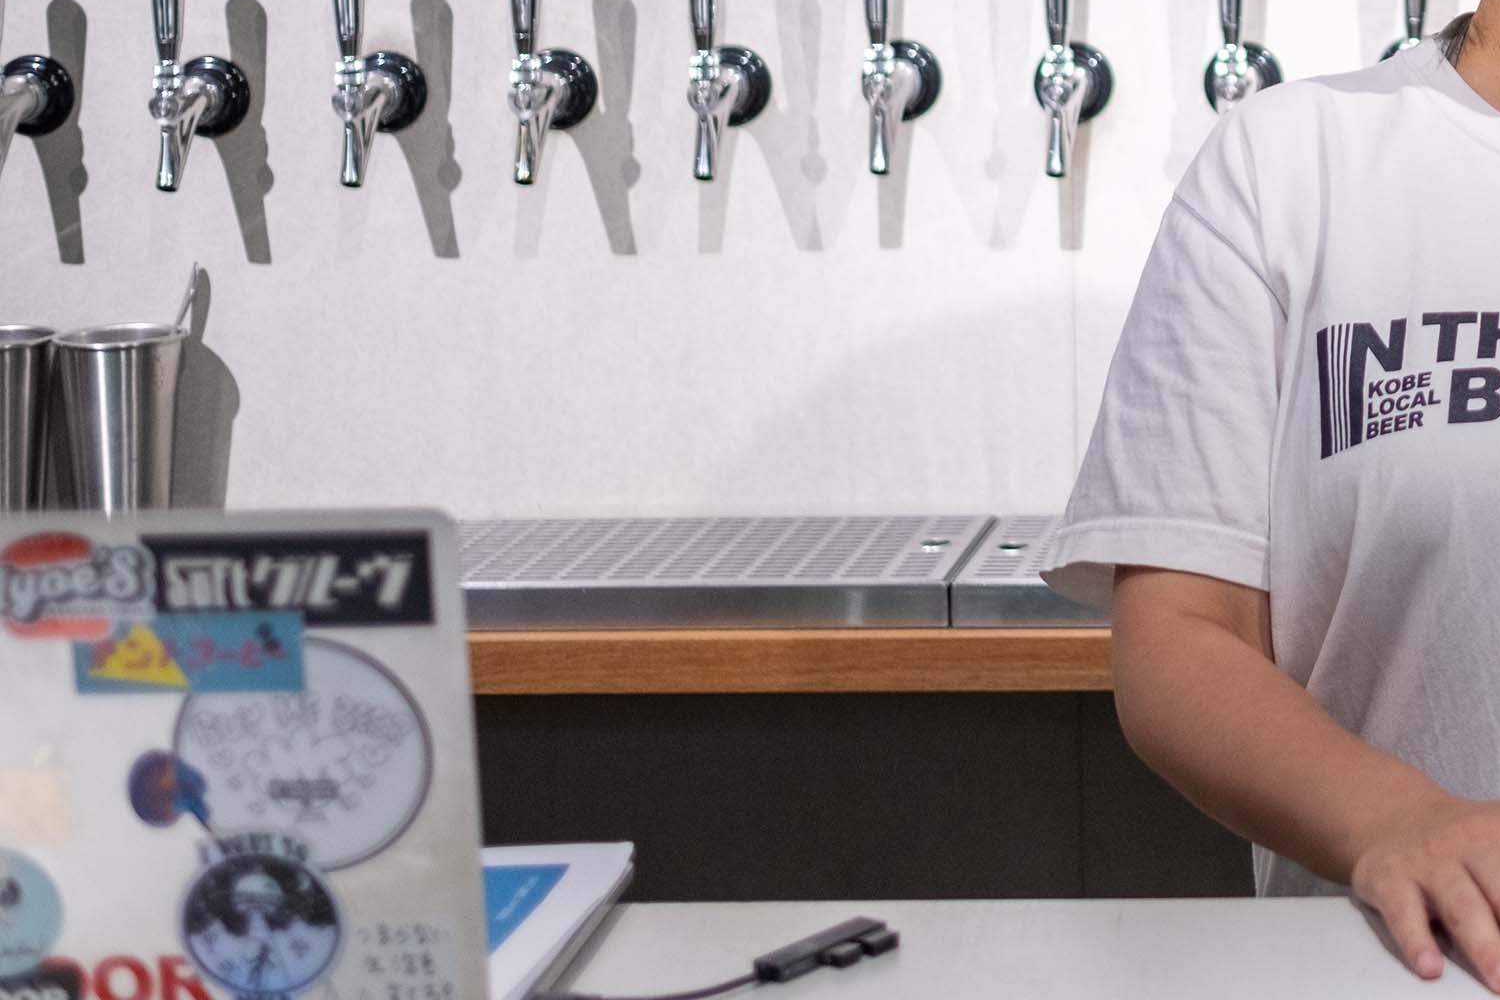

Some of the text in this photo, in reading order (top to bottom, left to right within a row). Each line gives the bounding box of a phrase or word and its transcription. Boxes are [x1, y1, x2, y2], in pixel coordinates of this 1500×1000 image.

[1368, 372, 1431, 398] KOBE
[1367, 390, 1441, 418] LOCAL
[1366, 411, 1424, 439] BEER
